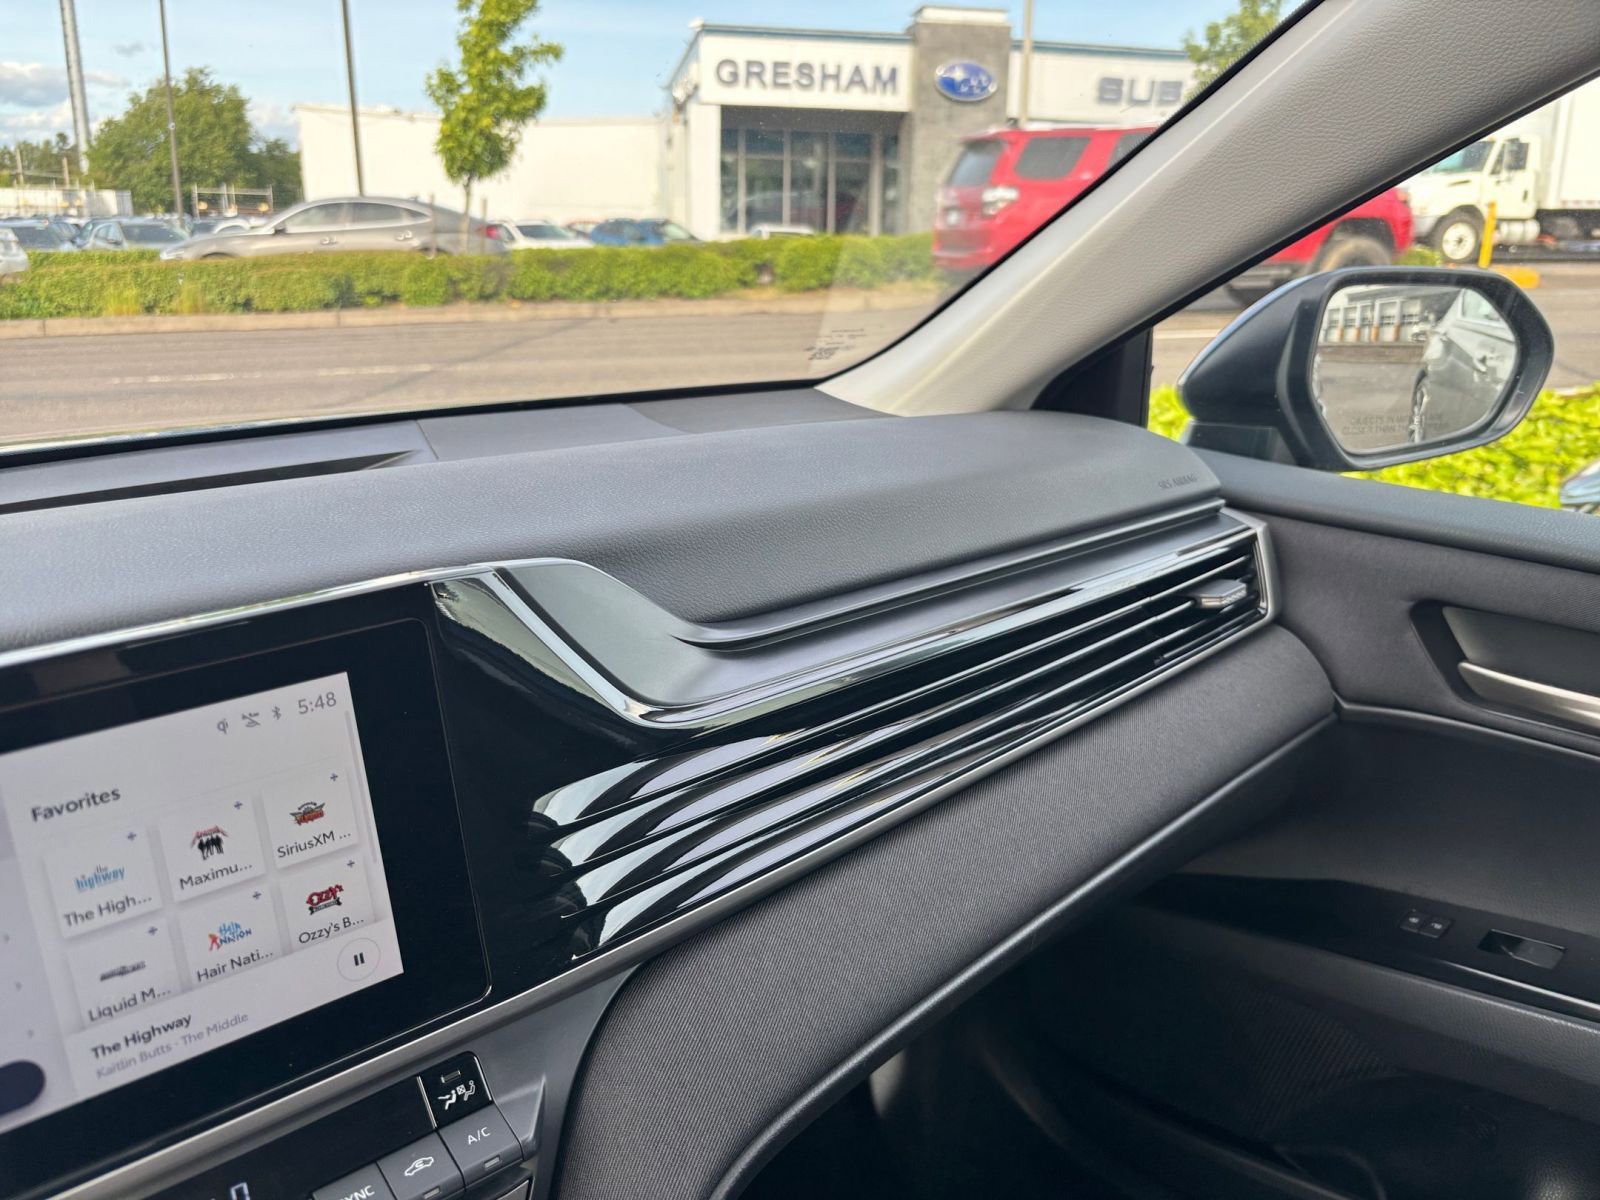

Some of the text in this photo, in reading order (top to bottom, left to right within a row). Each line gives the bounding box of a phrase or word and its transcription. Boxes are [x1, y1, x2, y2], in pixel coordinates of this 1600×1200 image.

[715, 58, 899, 95] GRESHAM
[298, 691, 337, 715] 5:48
[31, 788, 121, 822] Favorites
[277, 830, 335, 859] SiriusXM
[63, 911, 95, 927] The
[298, 921, 341, 945] Ozzy's
[197, 964, 227, 983] Hair
[88, 993, 138, 1023] Liquid
[91, 1014, 193, 1060] The Highway
[139, 1043, 174, 1064] Butts
[181, 1032, 205, 1047] The
[206, 1013, 249, 1036] Middle
[466, 1126, 491, 1146] A/C
